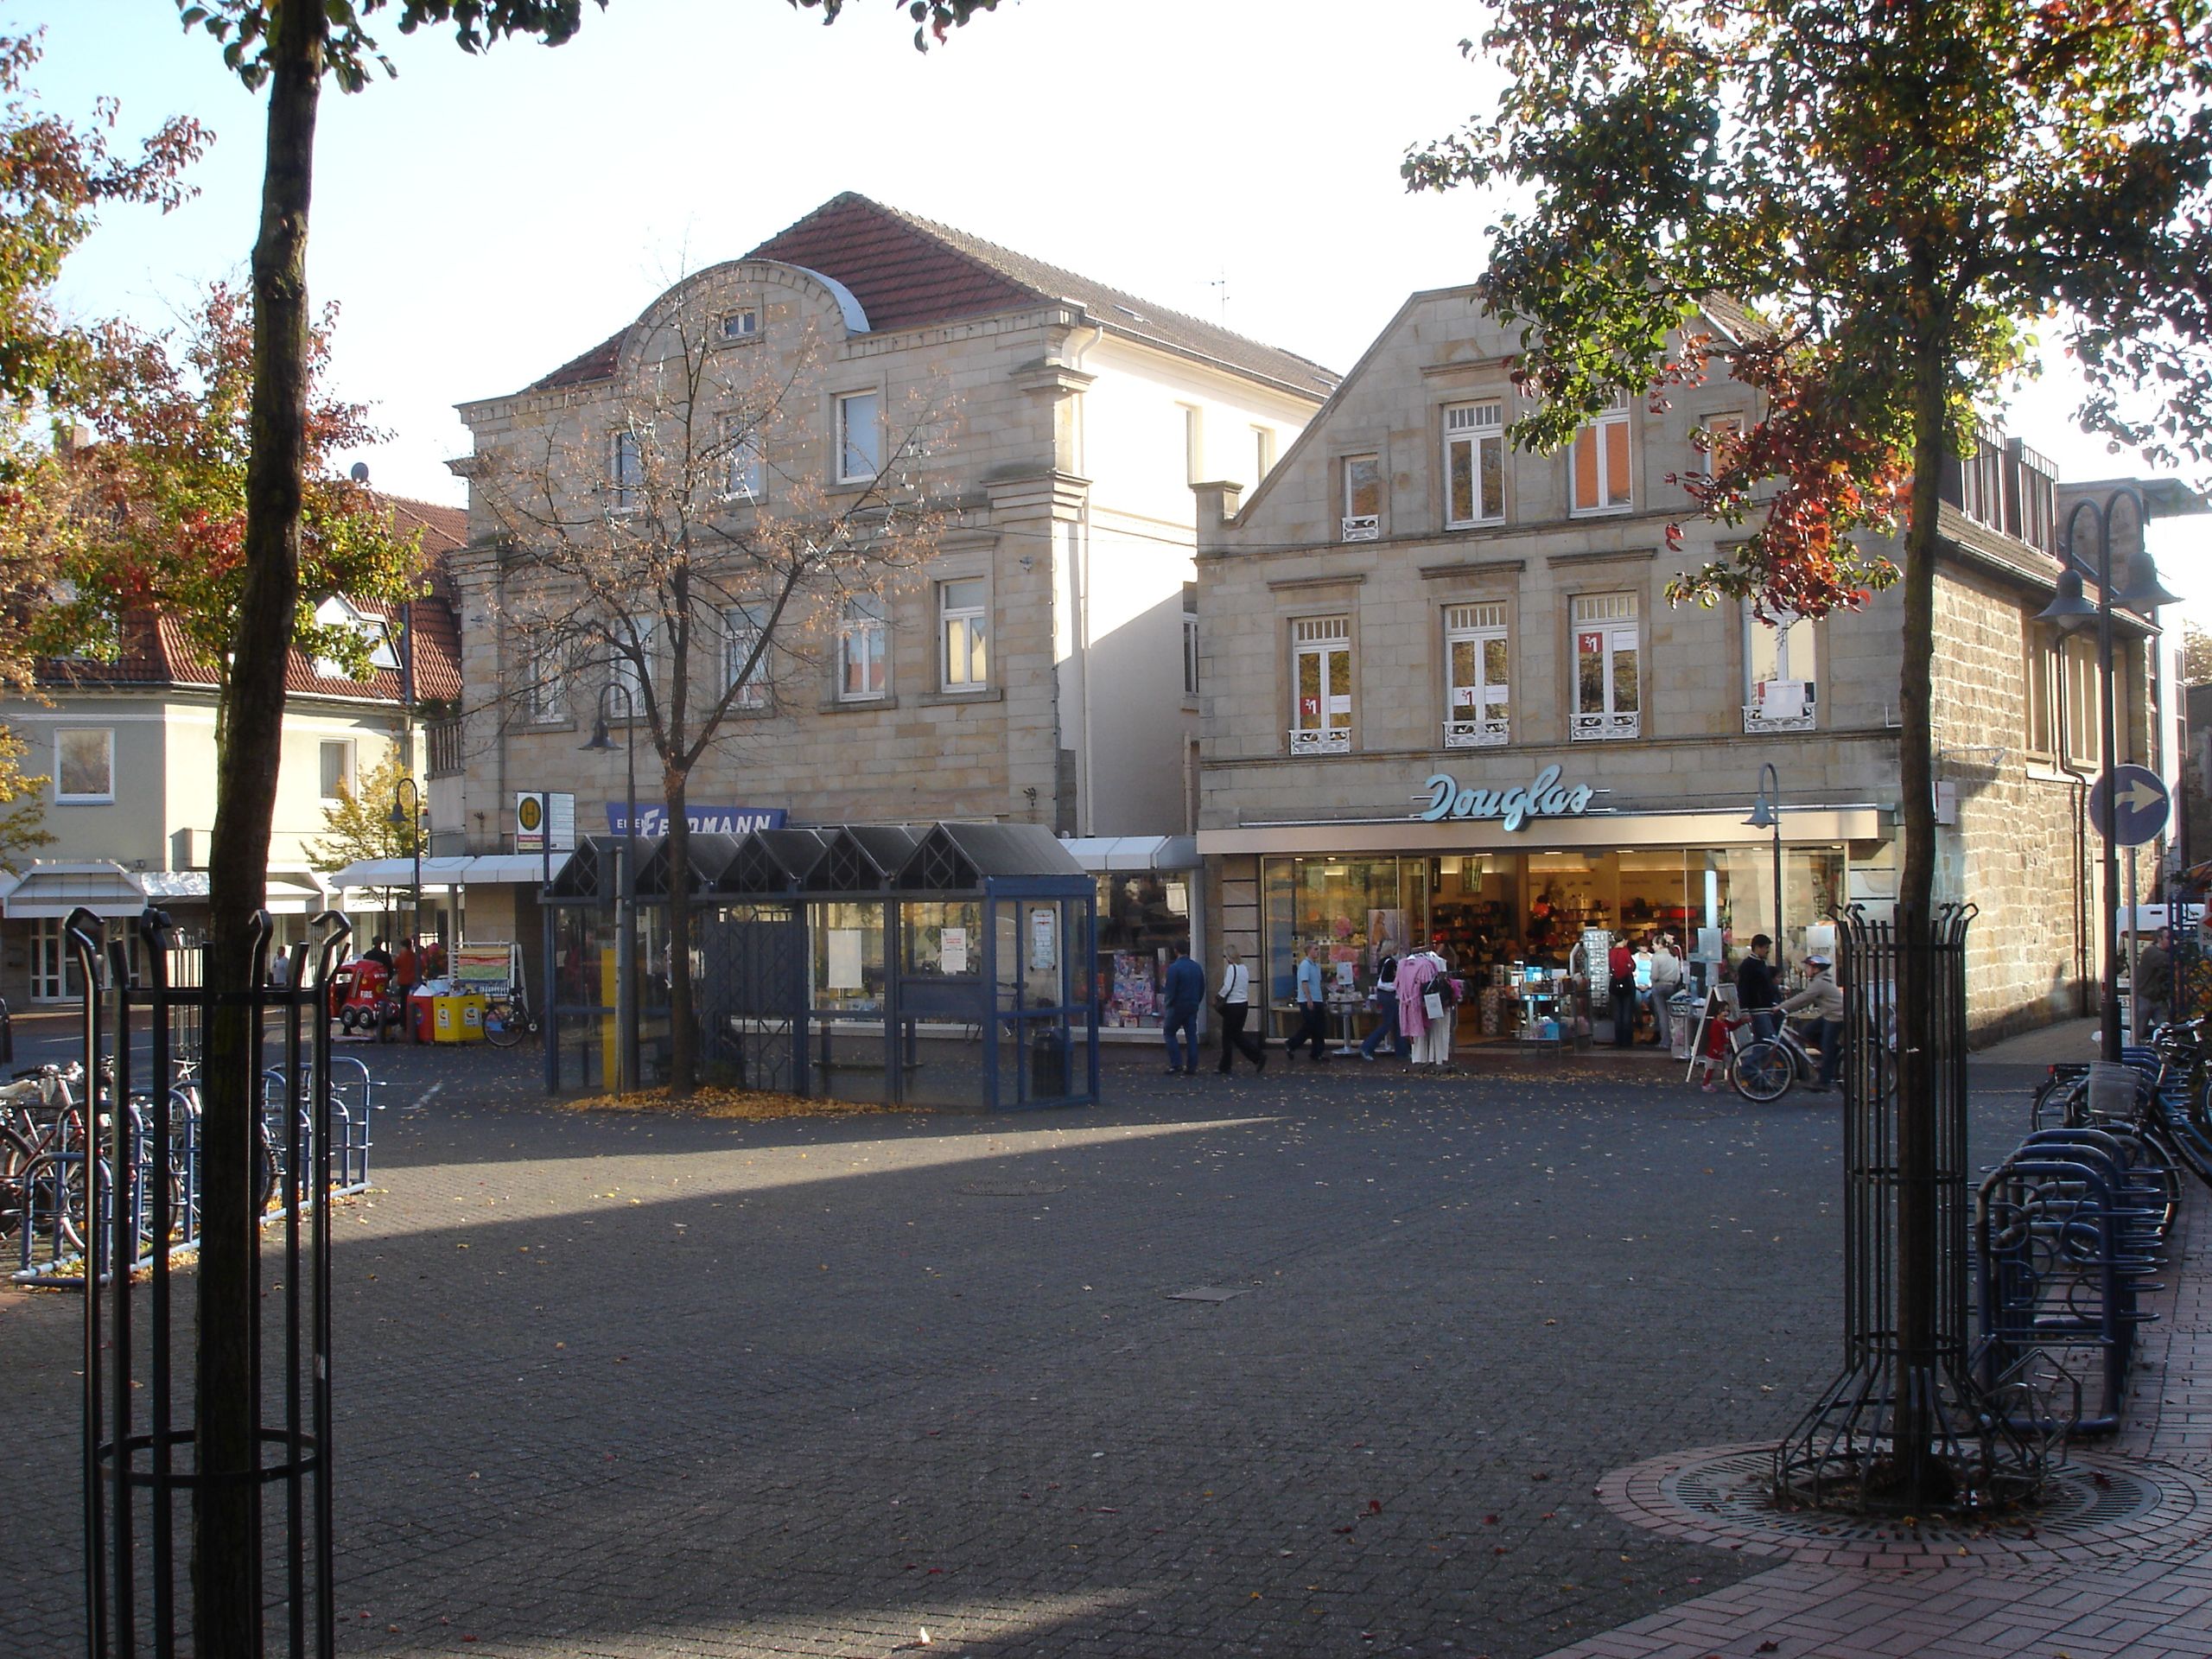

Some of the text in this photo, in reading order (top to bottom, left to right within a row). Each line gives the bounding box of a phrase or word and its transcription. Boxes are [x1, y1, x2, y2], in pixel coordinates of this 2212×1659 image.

[1421, 764, 1593, 832] Douglas
[525, 804, 535, 823] H
[617, 809, 771, 836] EIE FEDMANN
